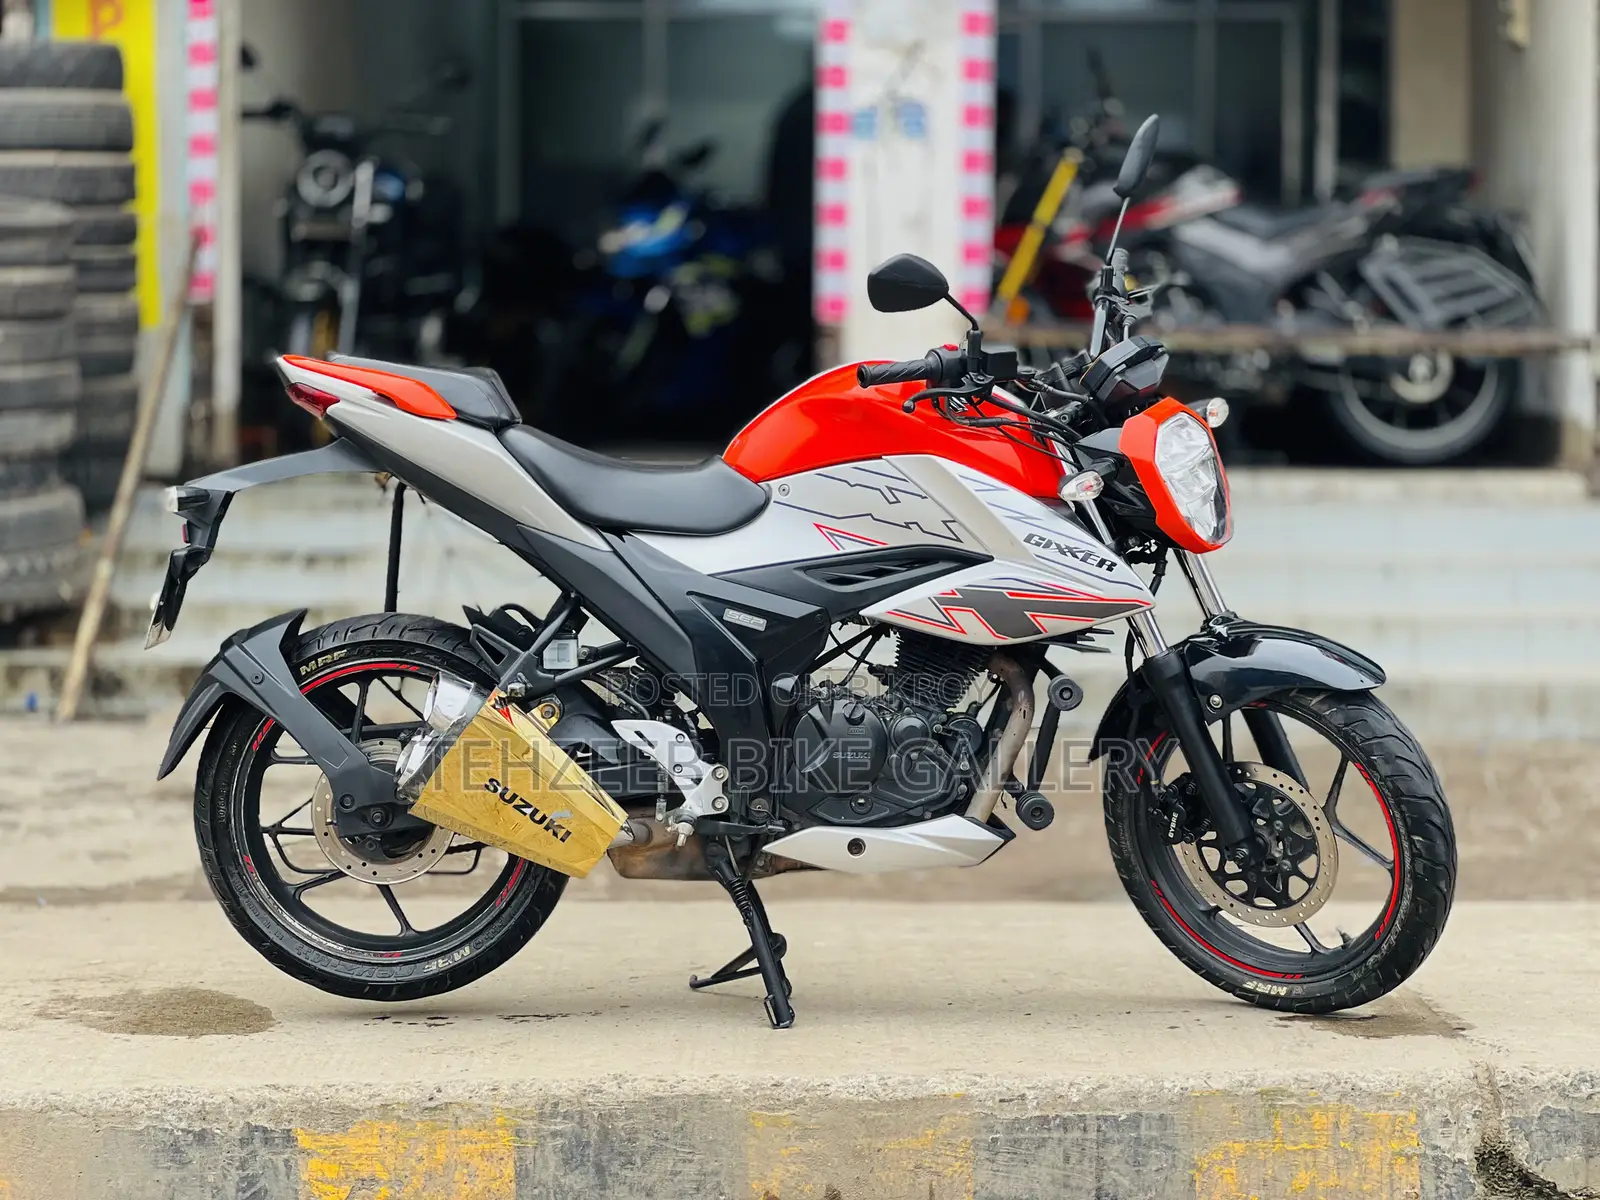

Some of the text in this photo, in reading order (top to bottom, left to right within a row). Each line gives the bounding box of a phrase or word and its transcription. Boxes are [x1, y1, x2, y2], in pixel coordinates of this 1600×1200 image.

[1023, 533, 1117, 572] GIXXER
[726, 609, 765, 625] SEP
[300, 649, 347, 676] MRF
[832, 751, 870, 759] SUZUKI
[484, 778, 572, 843] SUZUKI
[422, 945, 471, 973] MRF
[1242, 980, 1288, 996] MRF
